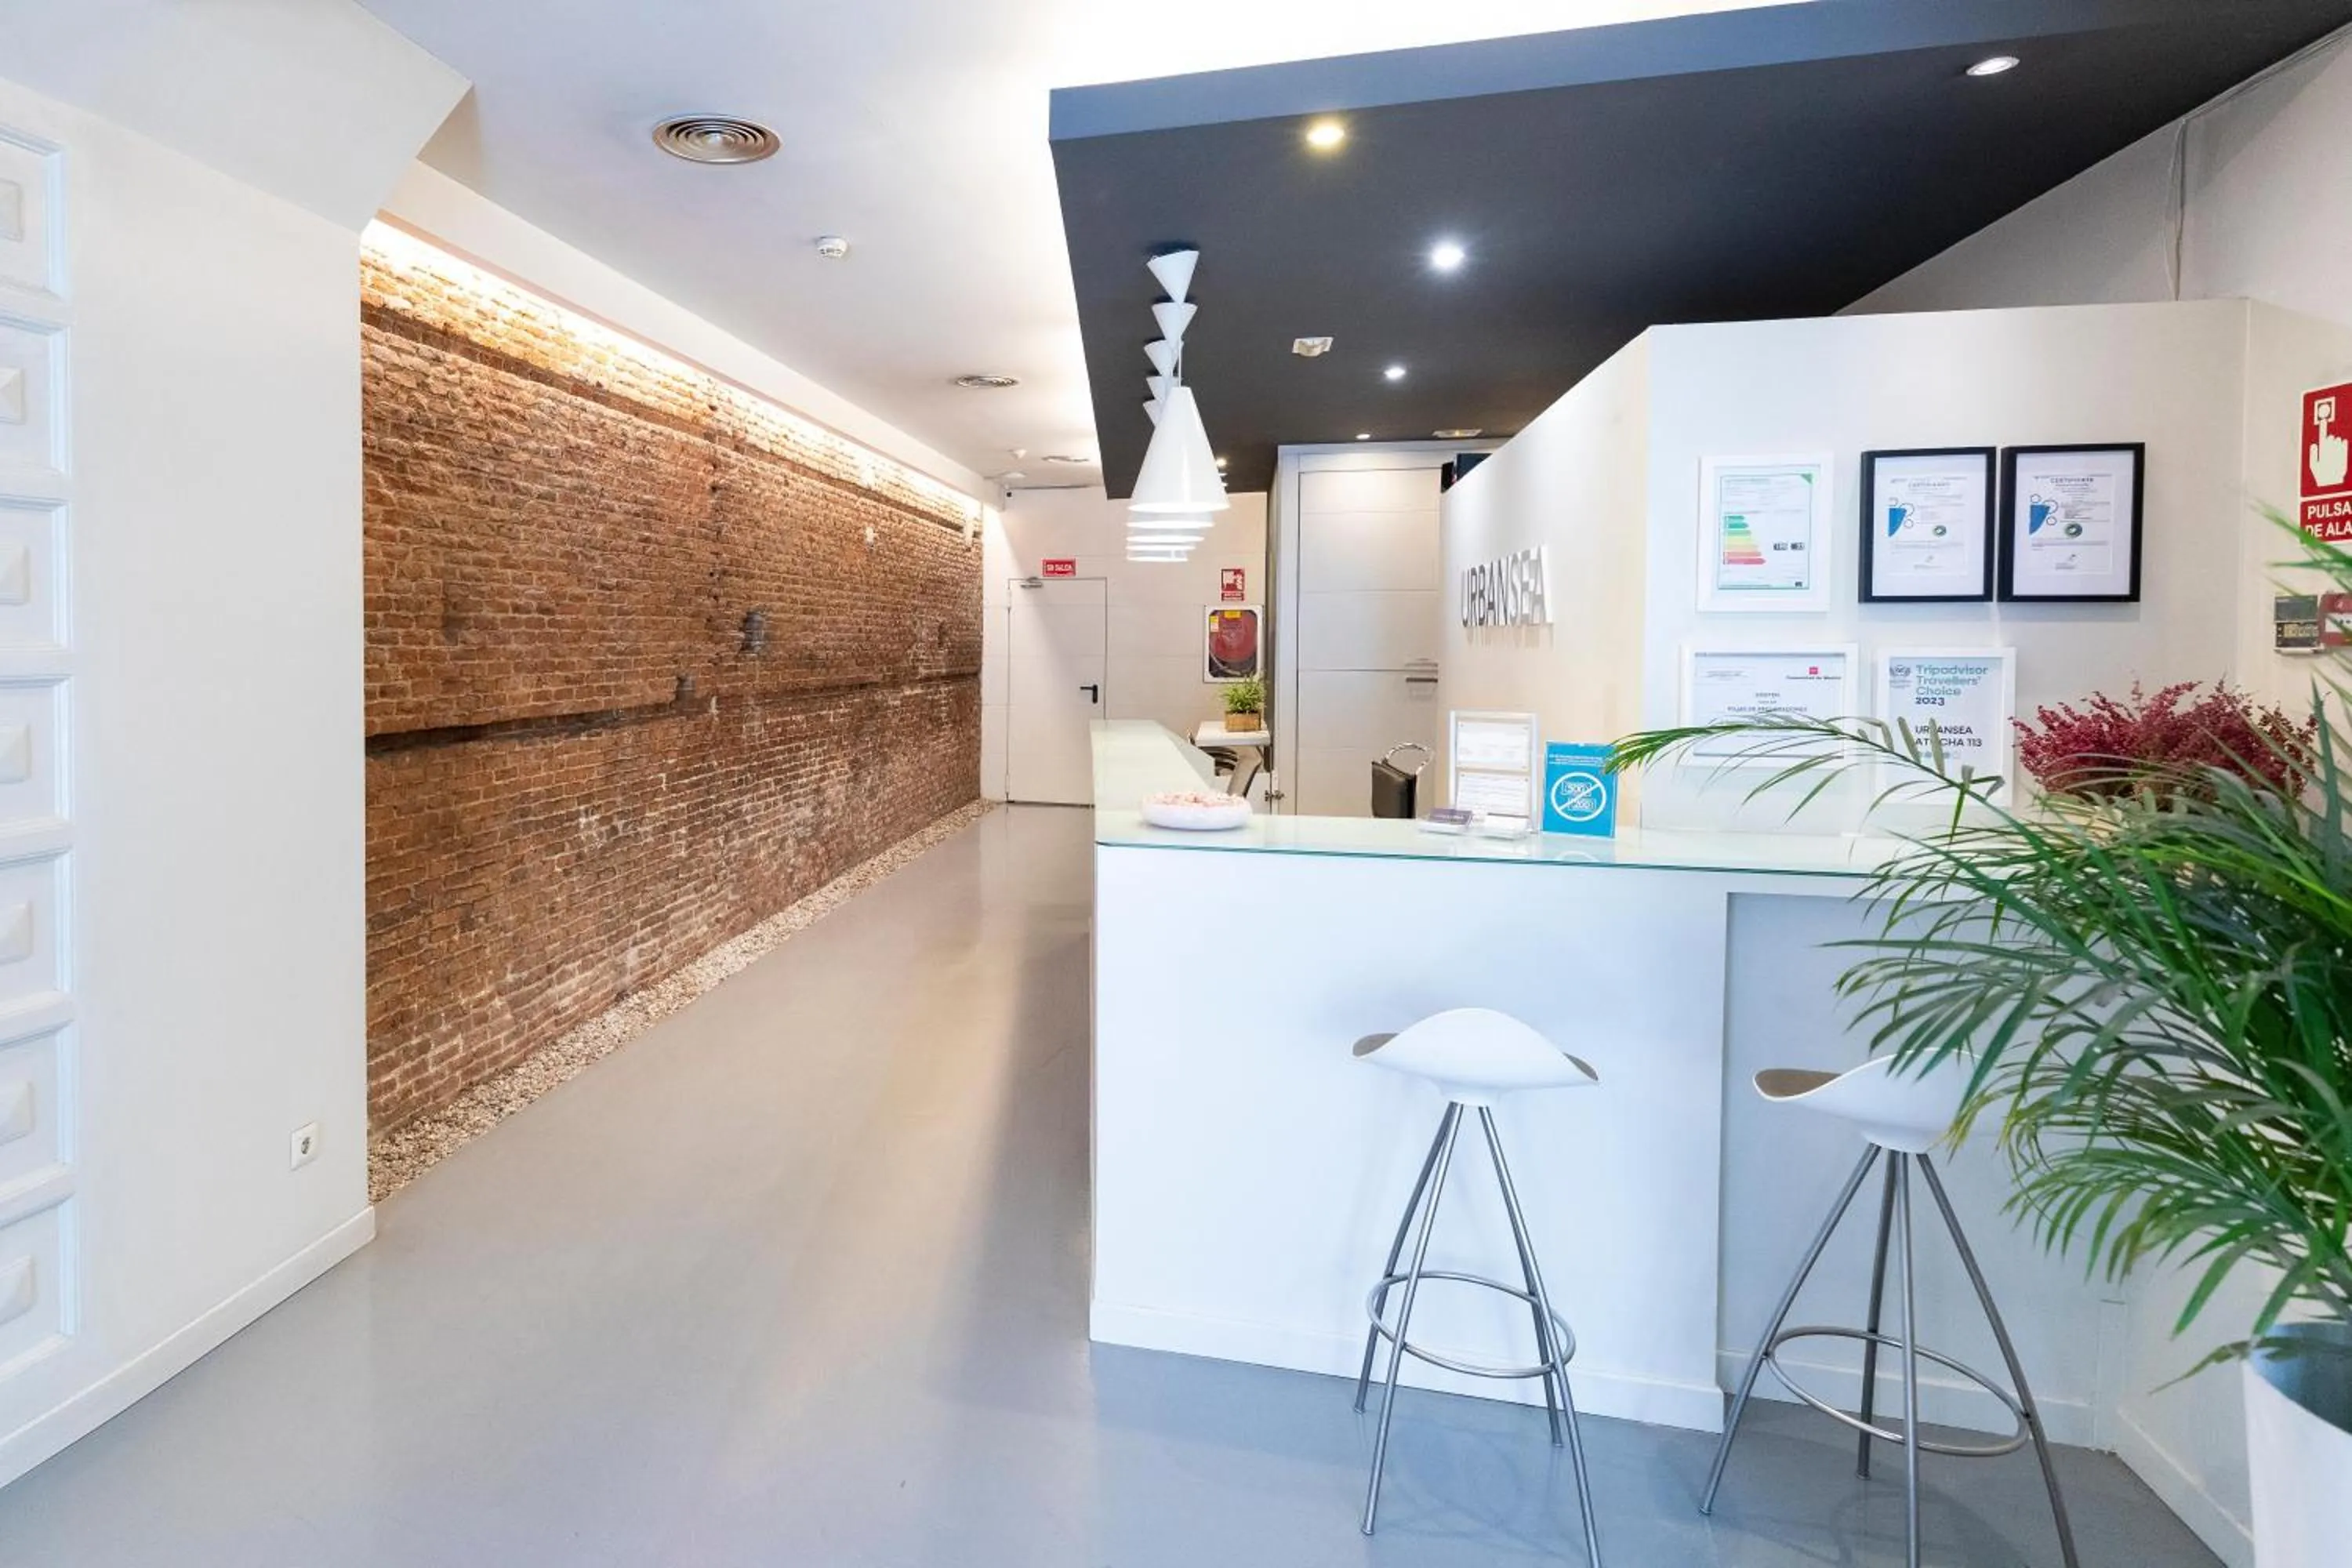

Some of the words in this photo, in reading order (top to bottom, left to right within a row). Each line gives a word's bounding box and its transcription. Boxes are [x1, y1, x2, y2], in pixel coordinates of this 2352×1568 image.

[1461, 546, 1551, 628] URBANSEA
[1915, 665, 1988, 675] Tripadvisor
[1916, 687, 1962, 695] Choice
[1915, 697, 1945, 706] 2023
[1915, 725, 1973, 735] URANSEA
[1915, 738, 1965, 746] ATCHA
[1966, 738, 1983, 747] 113
